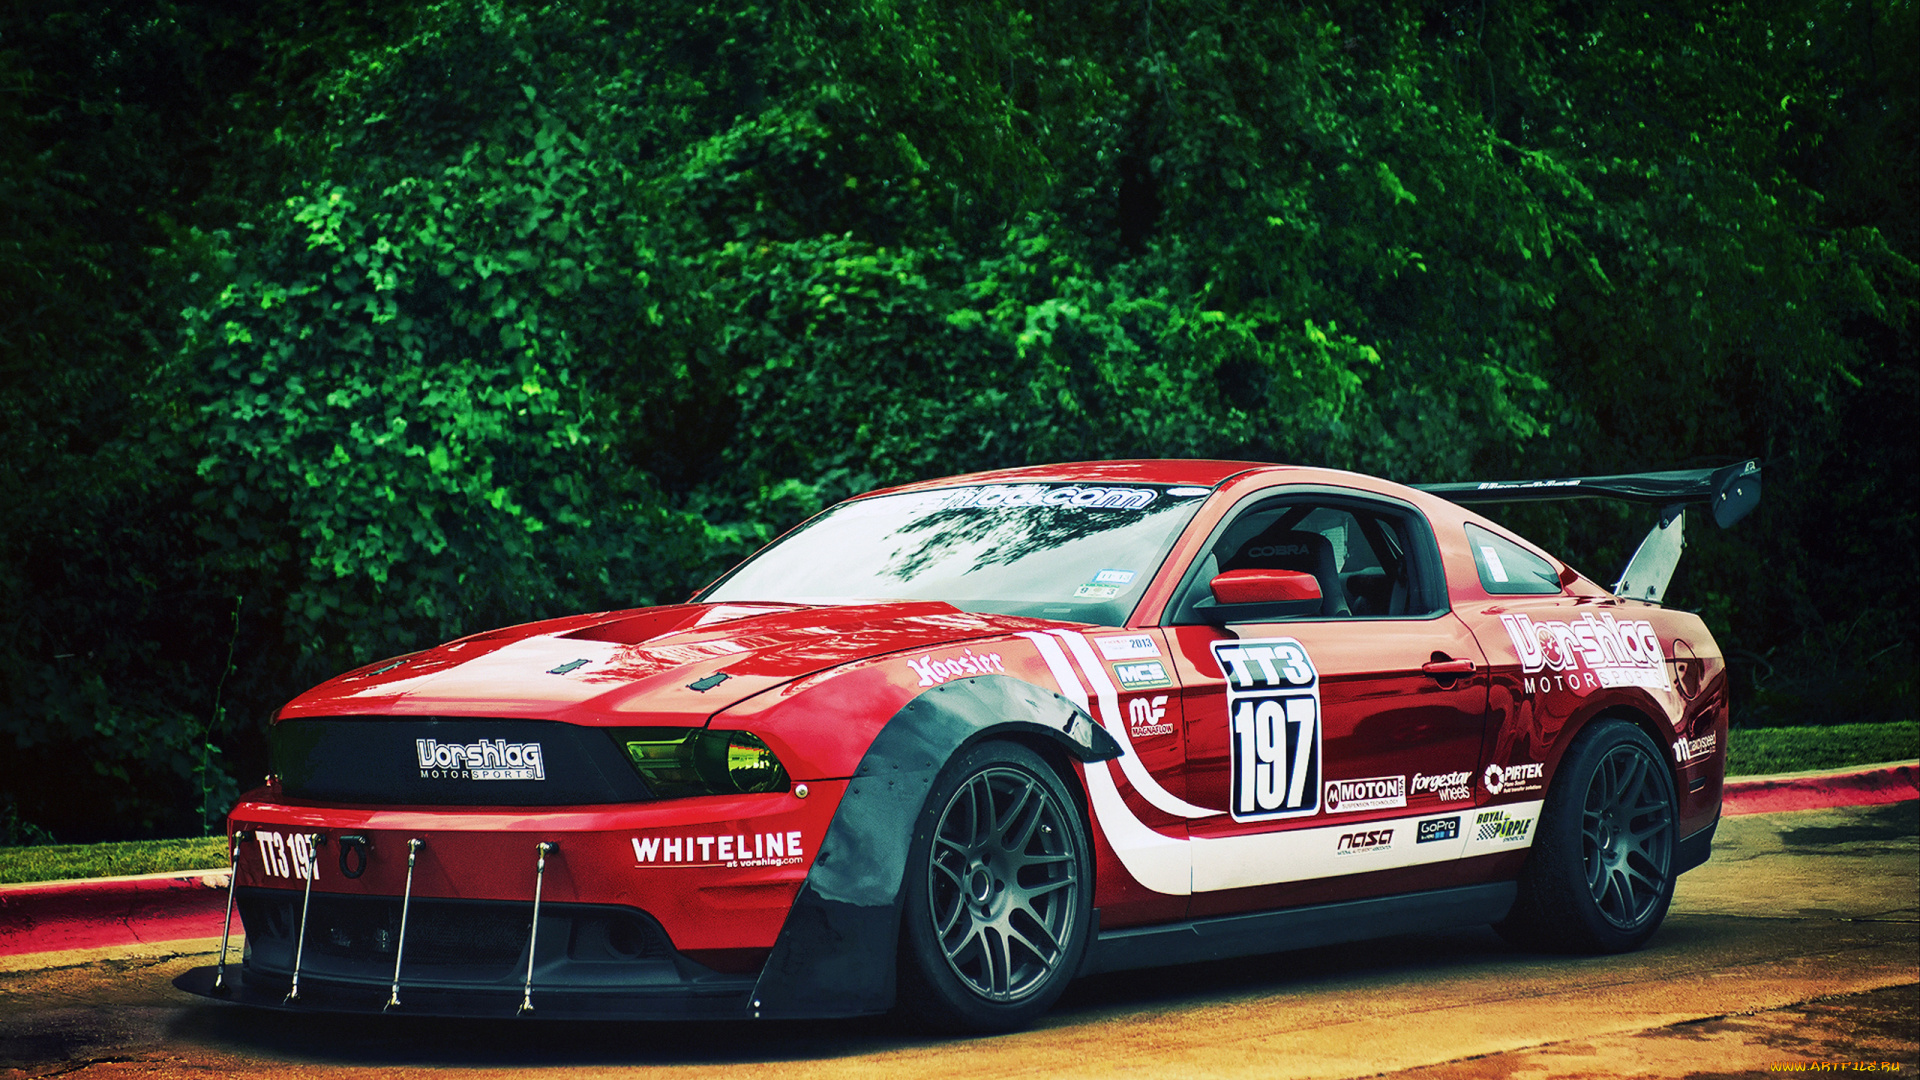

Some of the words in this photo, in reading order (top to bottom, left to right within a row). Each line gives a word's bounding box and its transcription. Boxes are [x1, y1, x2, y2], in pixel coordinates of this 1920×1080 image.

[1248, 544, 1309, 558] COBRA
[1129, 637, 1153, 649] 2013
[1500, 612, 1671, 691] Vorshlag
[907, 648, 1005, 687] Hoosier
[1117, 663, 1166, 682] MCS
[1217, 646, 1313, 687] TT3
[1131, 723, 1173, 737] MAGNAFLOW
[416, 739, 545, 780] Vorshlag
[1235, 698, 1315, 812] 197
[420, 770, 534, 779] MOTORSPORTS
[1504, 763, 1544, 781] PIRTEK
[1341, 780, 1398, 801] MOTON
[1410, 772, 1472, 795] forgestar
[1438, 784, 1470, 801] wheels
[1421, 820, 1456, 833] GoPro
[1476, 811, 1504, 824] ROYAL
[1492, 818, 1532, 838] PURPLE
[631, 831, 803, 862] WHITELINE
[1337, 829, 1394, 850] nasa
[255, 830, 290, 879] TT3
[726, 860, 738, 868] at
[740, 857, 803, 867] vorshlag.com
